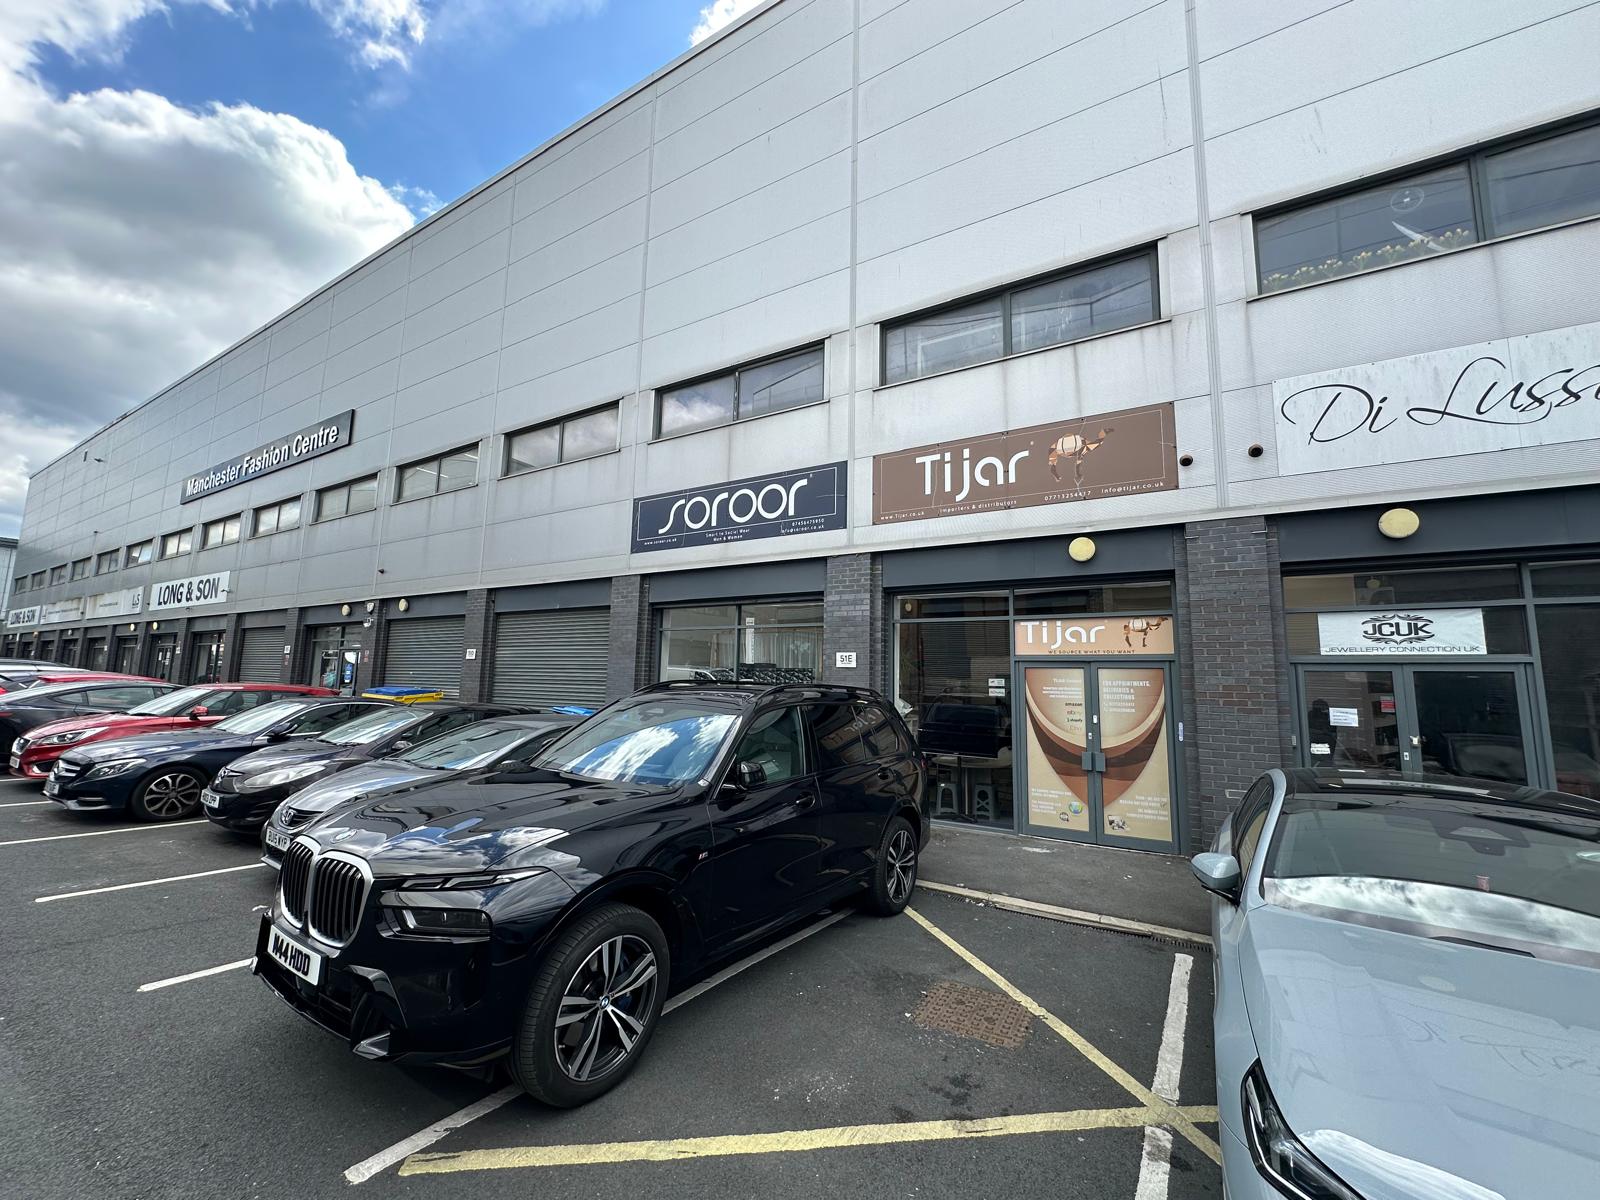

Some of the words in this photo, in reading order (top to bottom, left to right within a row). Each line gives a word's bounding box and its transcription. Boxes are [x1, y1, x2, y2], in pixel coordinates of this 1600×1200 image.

[1281, 384, 1398, 445] Di
[1406, 357, 1600, 425] Luss
[185, 463, 242, 497] Manchester
[242, 445, 290, 476] Fashion
[292, 425, 339, 457] Centre
[915, 448, 1029, 502] Tijar
[157, 583, 183, 606] LONG
[185, 581, 193, 601] &
[195, 577, 221, 600] SON
[10, 611, 21, 625] LONG
[27, 608, 37, 622] SON
[1363, 621, 1431, 637] JCUK
[1020, 620, 1106, 649] Tijar
[1325, 645, 1387, 654] JEWELLERY
[1388, 645, 1462, 653] CONNECTION
[289, 945, 311, 977] HDD
